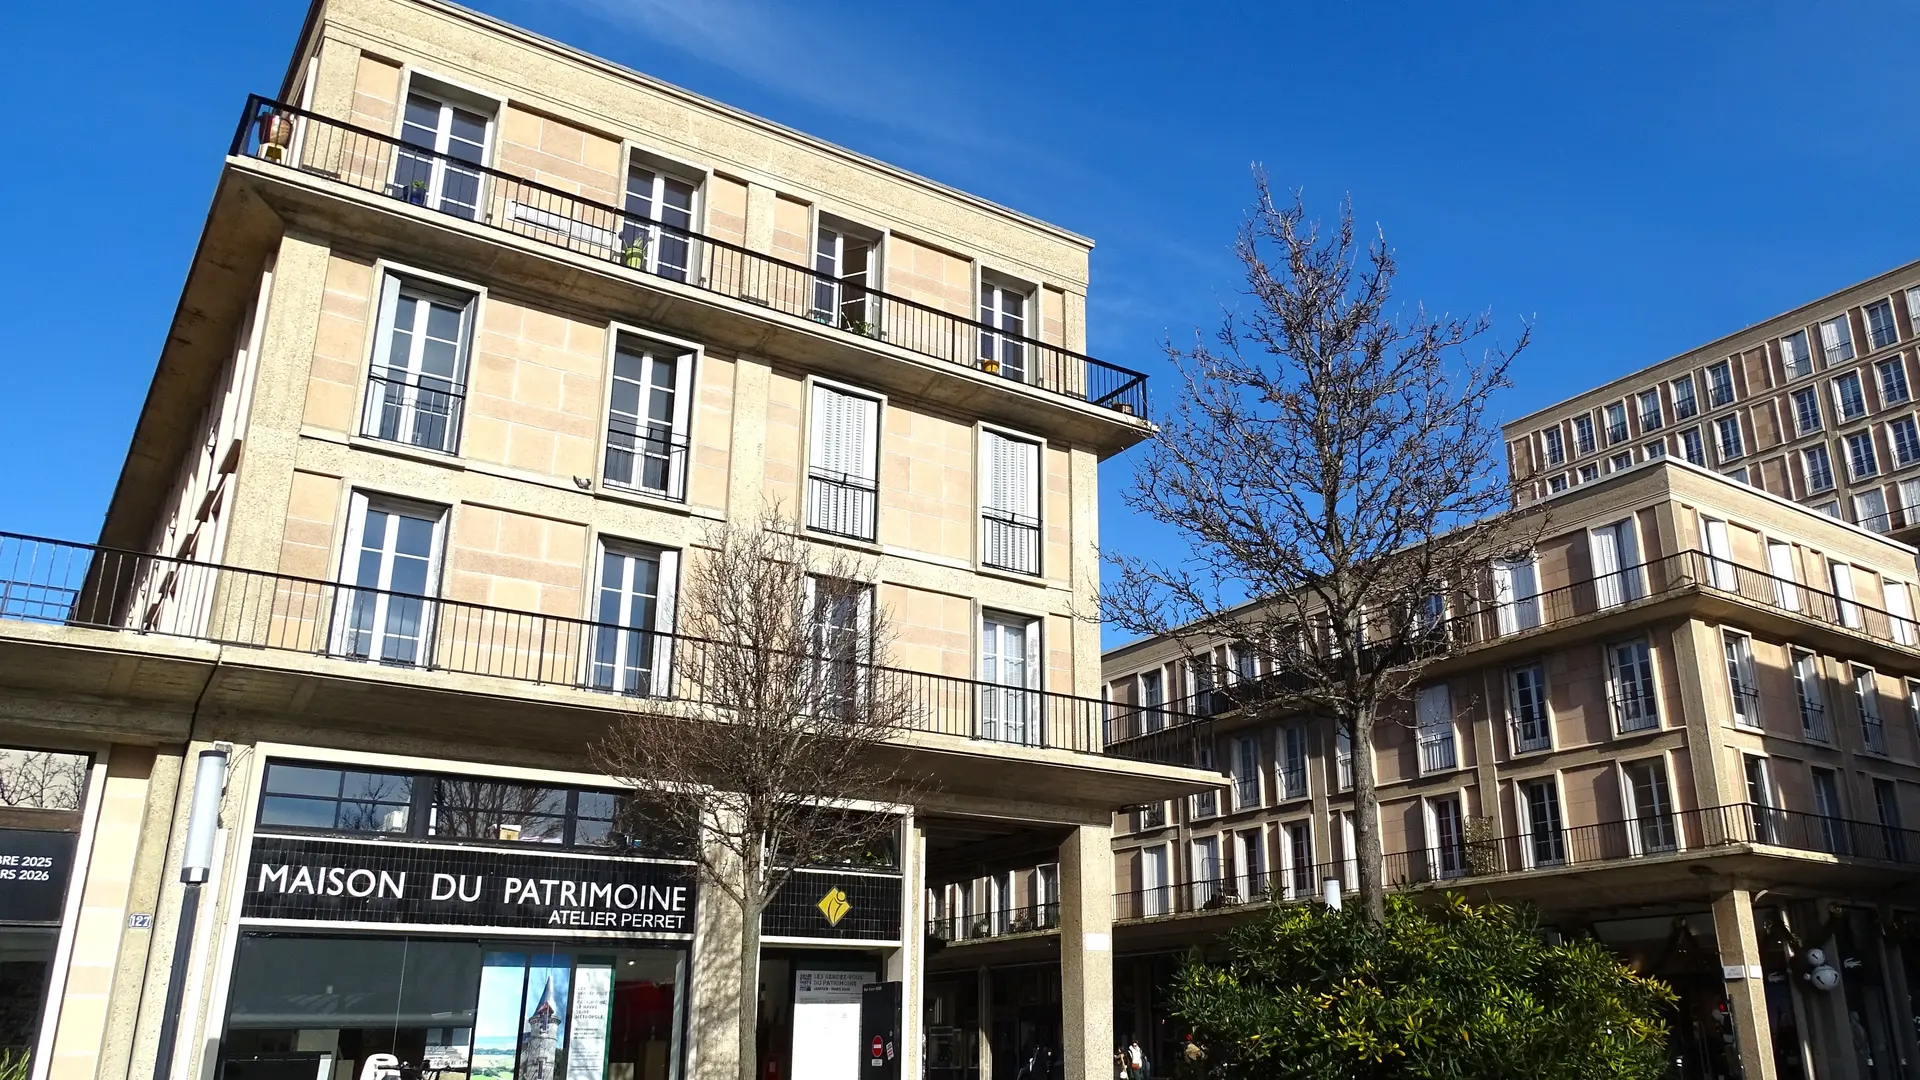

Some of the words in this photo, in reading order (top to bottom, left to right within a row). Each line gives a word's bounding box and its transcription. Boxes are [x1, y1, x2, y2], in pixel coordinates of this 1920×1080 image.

[21, 856, 53, 868] 2025
[18, 869, 50, 881] 2026
[258, 863, 406, 899] MAISON
[431, 873, 482, 902] DU
[503, 877, 687, 912] PATRIMOINE
[130, 915, 151, 927] 127
[548, 910, 617, 927] ATELIER
[621, 913, 686, 929] PERRET
